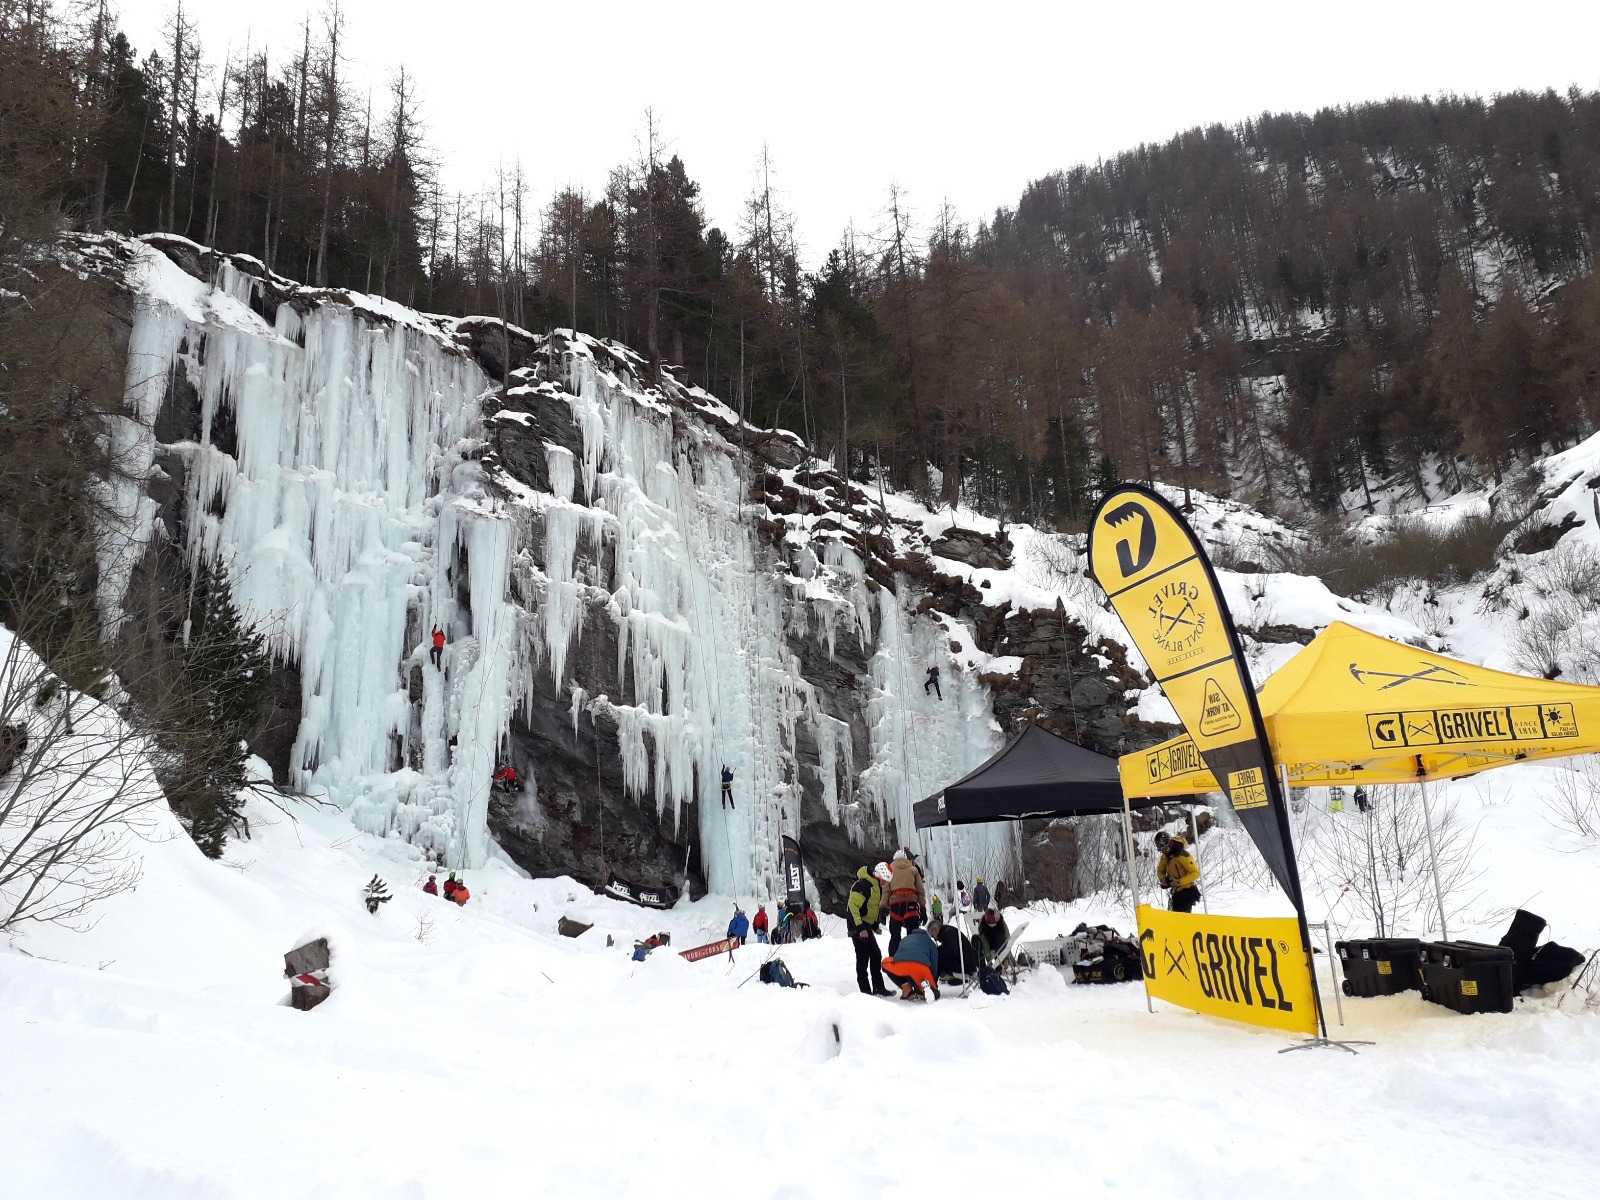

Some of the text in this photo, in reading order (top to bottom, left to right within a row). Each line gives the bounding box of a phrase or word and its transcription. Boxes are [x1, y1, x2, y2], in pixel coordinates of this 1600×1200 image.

[1514, 720, 1539, 728] SINCE
[1518, 726, 1538, 735] 1818
[1171, 743, 1198, 772] GRIVEL
[612, 880, 631, 896] PETZL
[640, 891, 660, 903] PETZL
